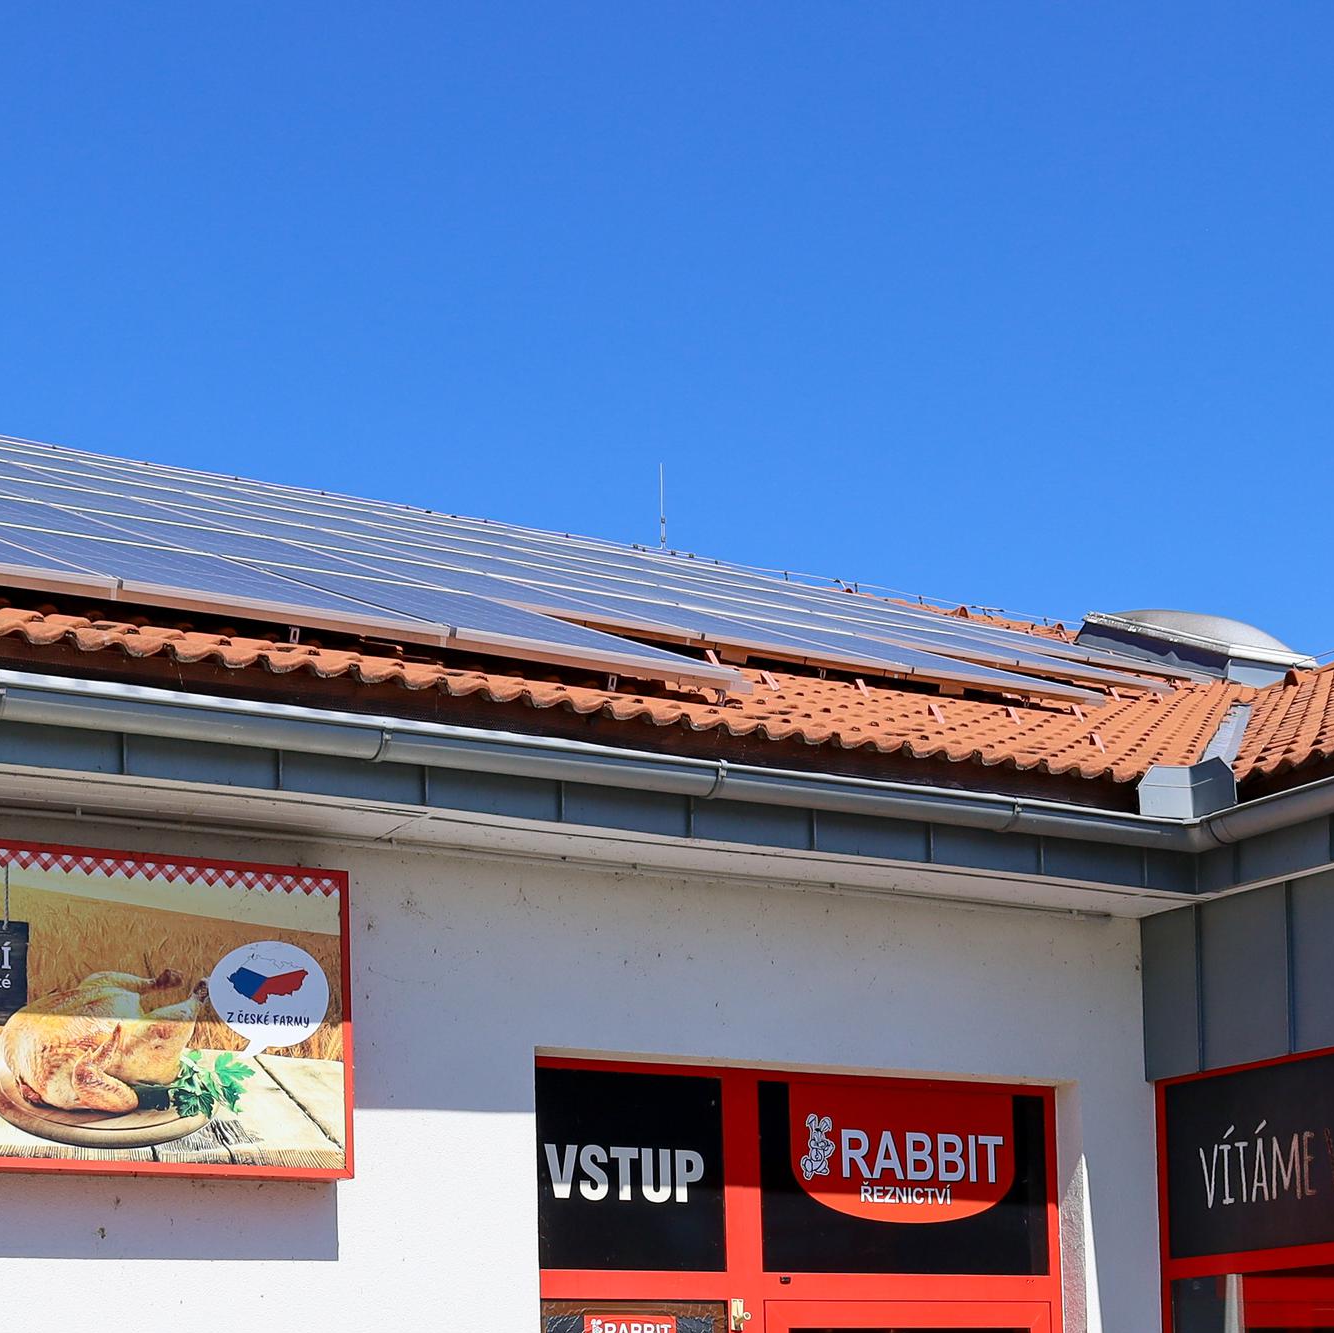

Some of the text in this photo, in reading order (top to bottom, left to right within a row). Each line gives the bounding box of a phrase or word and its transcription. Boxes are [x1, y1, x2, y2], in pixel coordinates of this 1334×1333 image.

[227, 1010, 310, 1028] Z ČESKÉ FARMY
[544, 1143, 704, 1203] VSTUP
[841, 1128, 1004, 1184] RABBIT
[1199, 1119, 1317, 1209] VÍTÁME
[860, 1181, 951, 1206] ŘEZNICTVÍ
